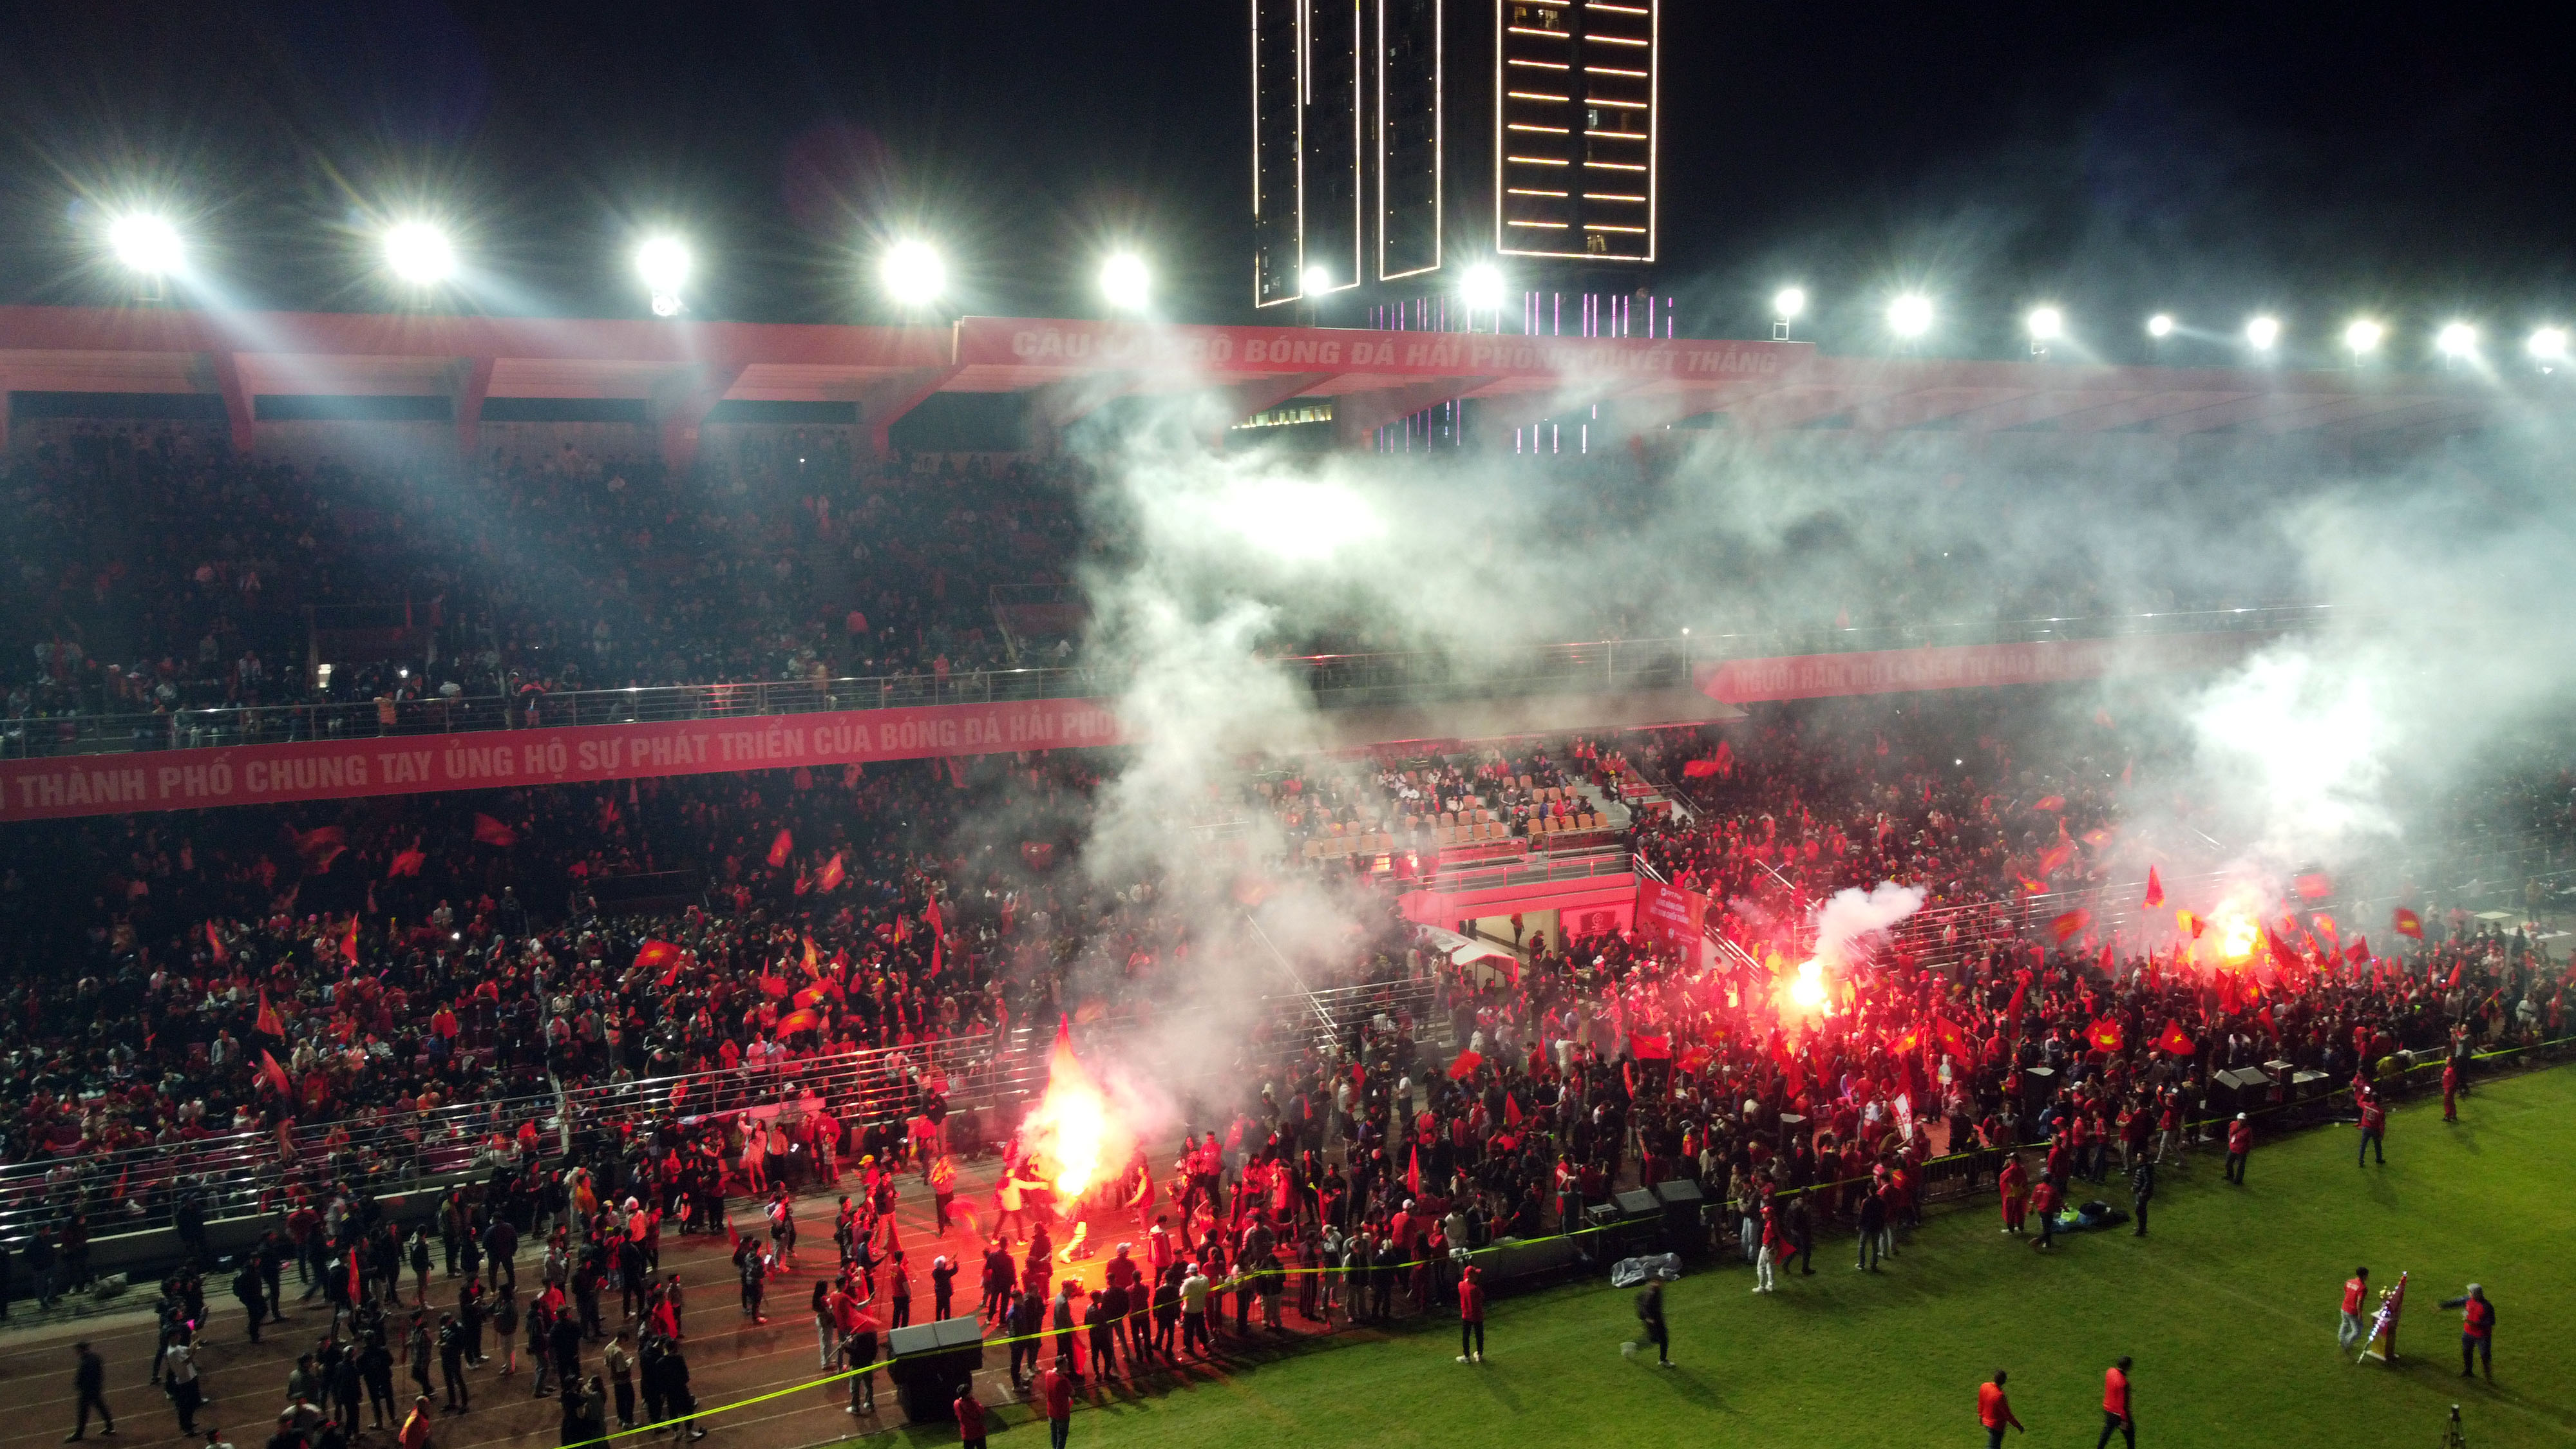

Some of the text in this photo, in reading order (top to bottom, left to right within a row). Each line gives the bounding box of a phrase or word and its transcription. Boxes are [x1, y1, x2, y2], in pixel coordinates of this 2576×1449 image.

[1012, 327, 1092, 359] CÂU
[1245, 334, 1340, 365] BÓNG
[1351, 338, 1396, 365] ĐÁ
[1406, 337, 1464, 367] HẢI
[1687, 343, 1777, 373] THẮNG
[17, 765, 146, 808] THÀNH
[158, 752, 233, 799] PHỐ
[246, 753, 368, 792] CHUNG
[378, 750, 433, 784] TAY
[445, 738, 514, 779] ỦNG
[524, 736, 567, 779] HỘ
[579, 736, 623, 776] SỰ
[630, 729, 708, 768] PHÁT
[718, 717, 804, 762] TRIỂN
[813, 715, 873, 755] CỦA
[880, 715, 956, 752] BÓNG
[964, 710, 1002, 745] ĐÁ
[1009, 705, 1053, 741] HẢI
